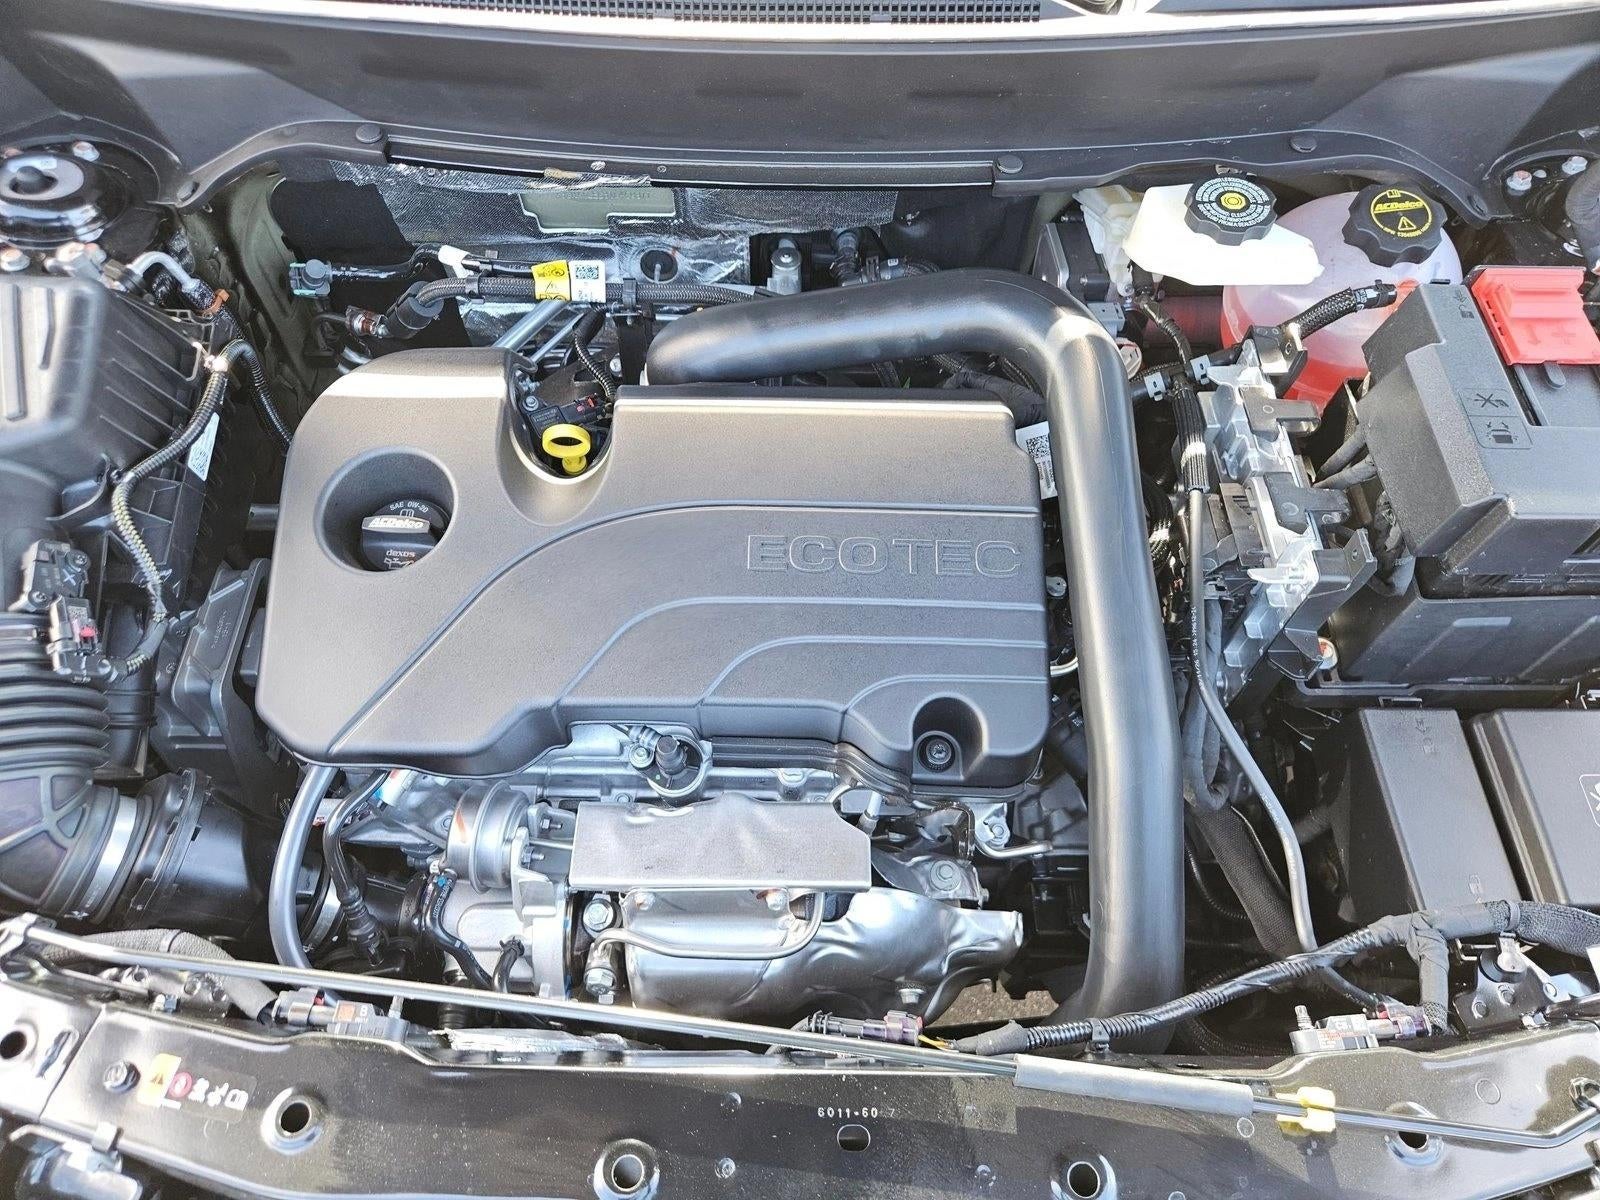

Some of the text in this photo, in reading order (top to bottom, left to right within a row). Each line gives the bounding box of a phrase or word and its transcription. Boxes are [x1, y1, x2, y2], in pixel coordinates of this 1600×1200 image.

[389, 501, 429, 513] SAE 0W-20
[368, 517, 424, 529] ACDelco
[747, 534, 1021, 578] ECOTEC
[817, 1107, 878, 1118] 6011-60
